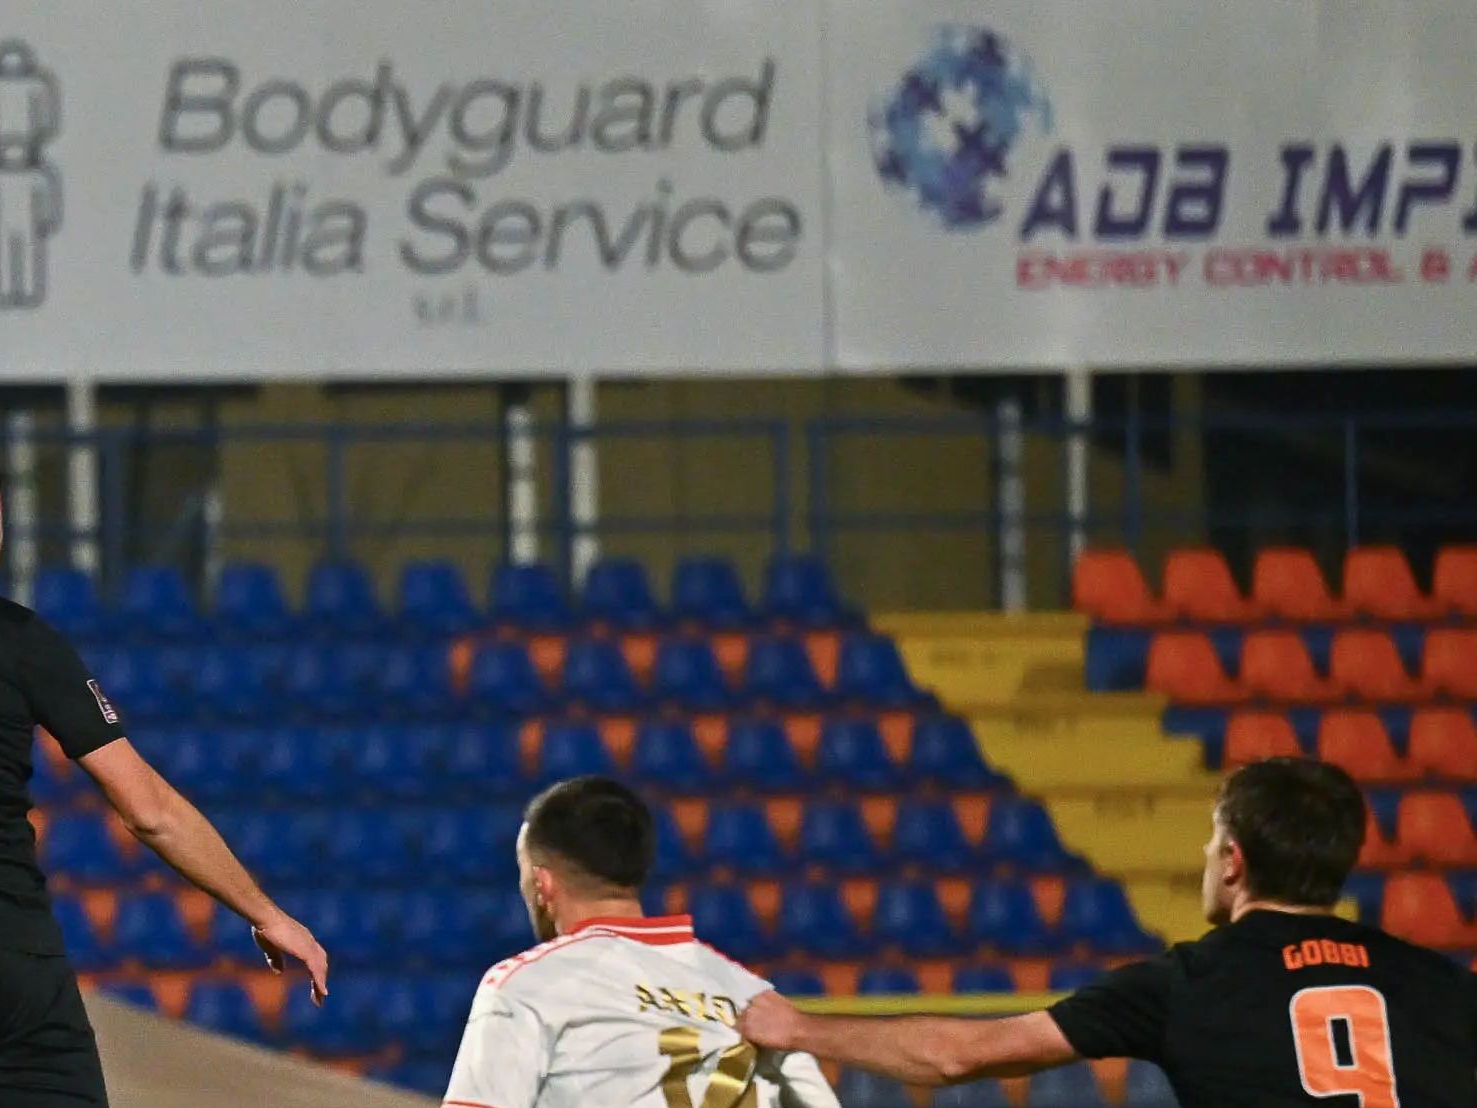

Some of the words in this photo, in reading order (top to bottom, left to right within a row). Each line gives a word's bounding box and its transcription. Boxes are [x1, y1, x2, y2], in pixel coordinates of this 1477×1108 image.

[157, 57, 776, 178] Bodyguard
[129, 181, 367, 276] Italia
[398, 177, 803, 277] Service
[1018, 142, 1230, 241] ADB
[1266, 142, 1477, 240] IMP
[1015, 246, 1190, 290] ENERGY
[1203, 246, 1404, 287] CONTROL
[1282, 939, 1371, 971] GOBBI
